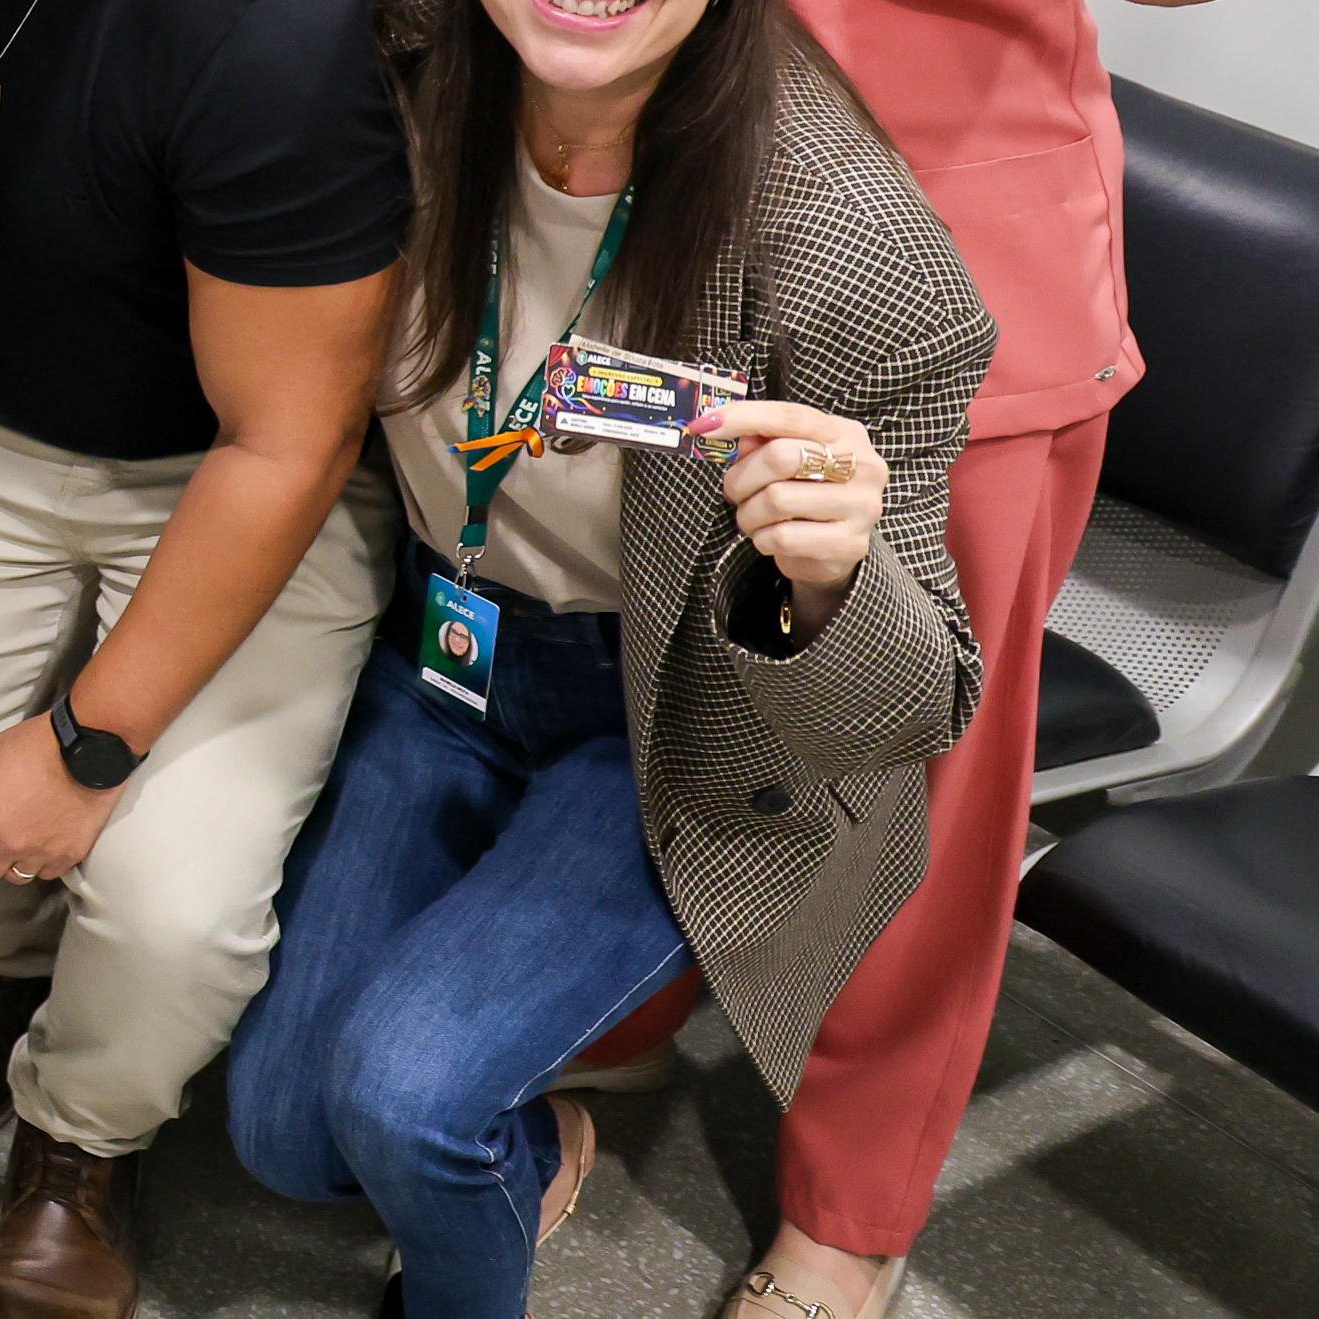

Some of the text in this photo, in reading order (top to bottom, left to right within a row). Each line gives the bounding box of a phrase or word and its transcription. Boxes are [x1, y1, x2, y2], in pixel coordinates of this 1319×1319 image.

[587, 355, 611, 366] ALECE
[623, 352, 647, 368] Souza
[597, 370, 654, 384] INGRESSO ESPECIAL
[577, 375, 629, 399] EMOÇÕES
[629, 384, 646, 402] EM
[646, 386, 676, 407] CENA
[446, 600, 475, 621] ALECE
